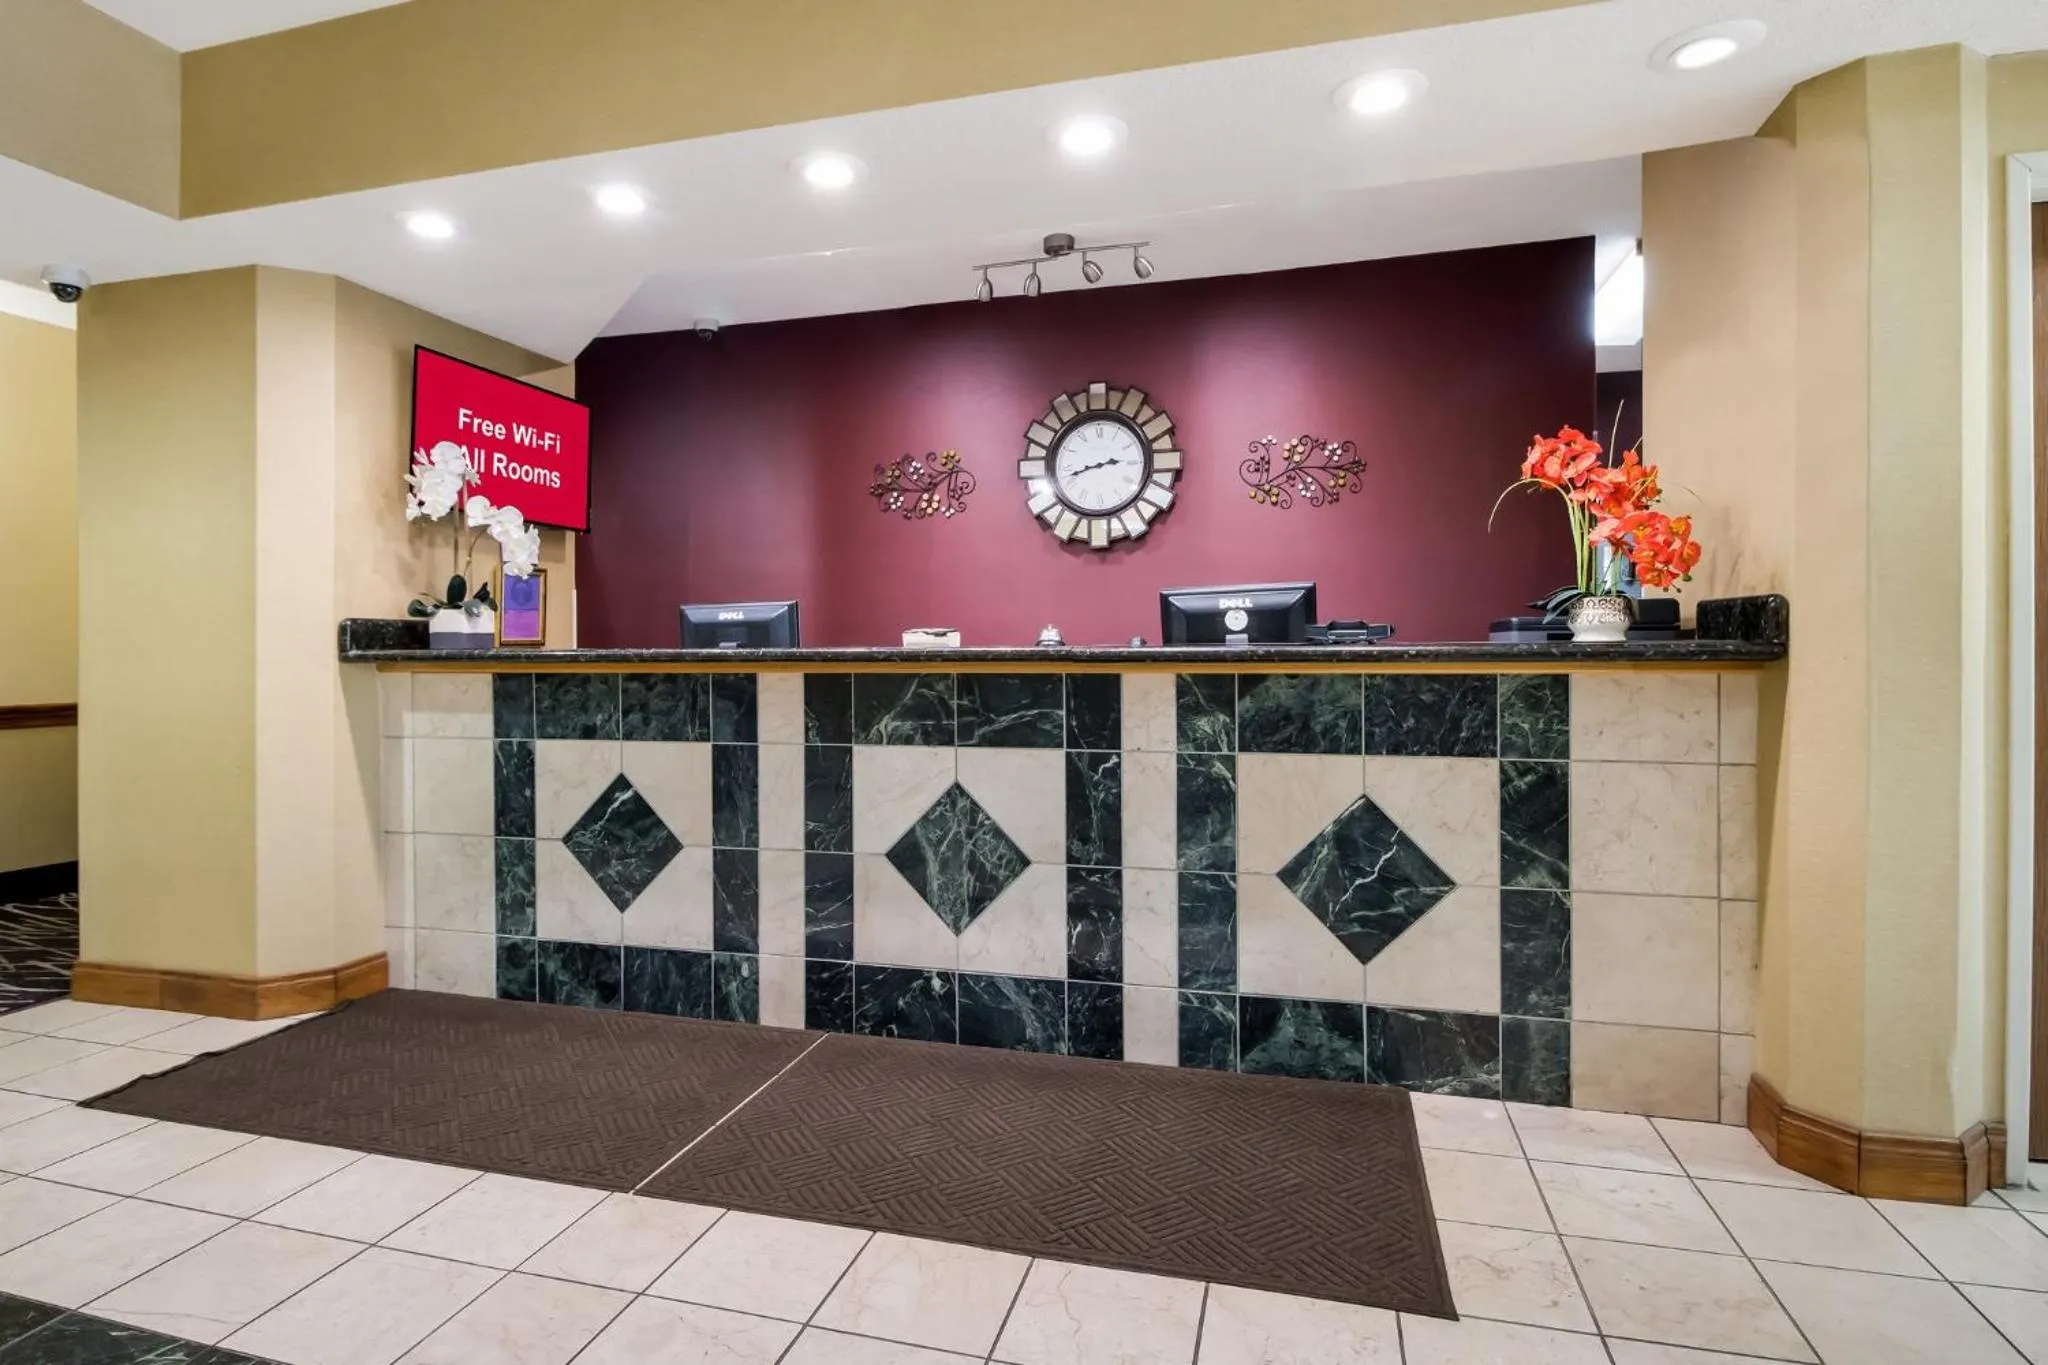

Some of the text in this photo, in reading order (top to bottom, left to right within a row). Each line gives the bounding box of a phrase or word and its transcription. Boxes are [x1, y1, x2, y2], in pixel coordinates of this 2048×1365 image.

[458, 407, 561, 454] Free Wi-Fi
[493, 452, 561, 488] Rooms
[1218, 598, 1253, 609] DELL
[718, 611, 745, 620] DELL
